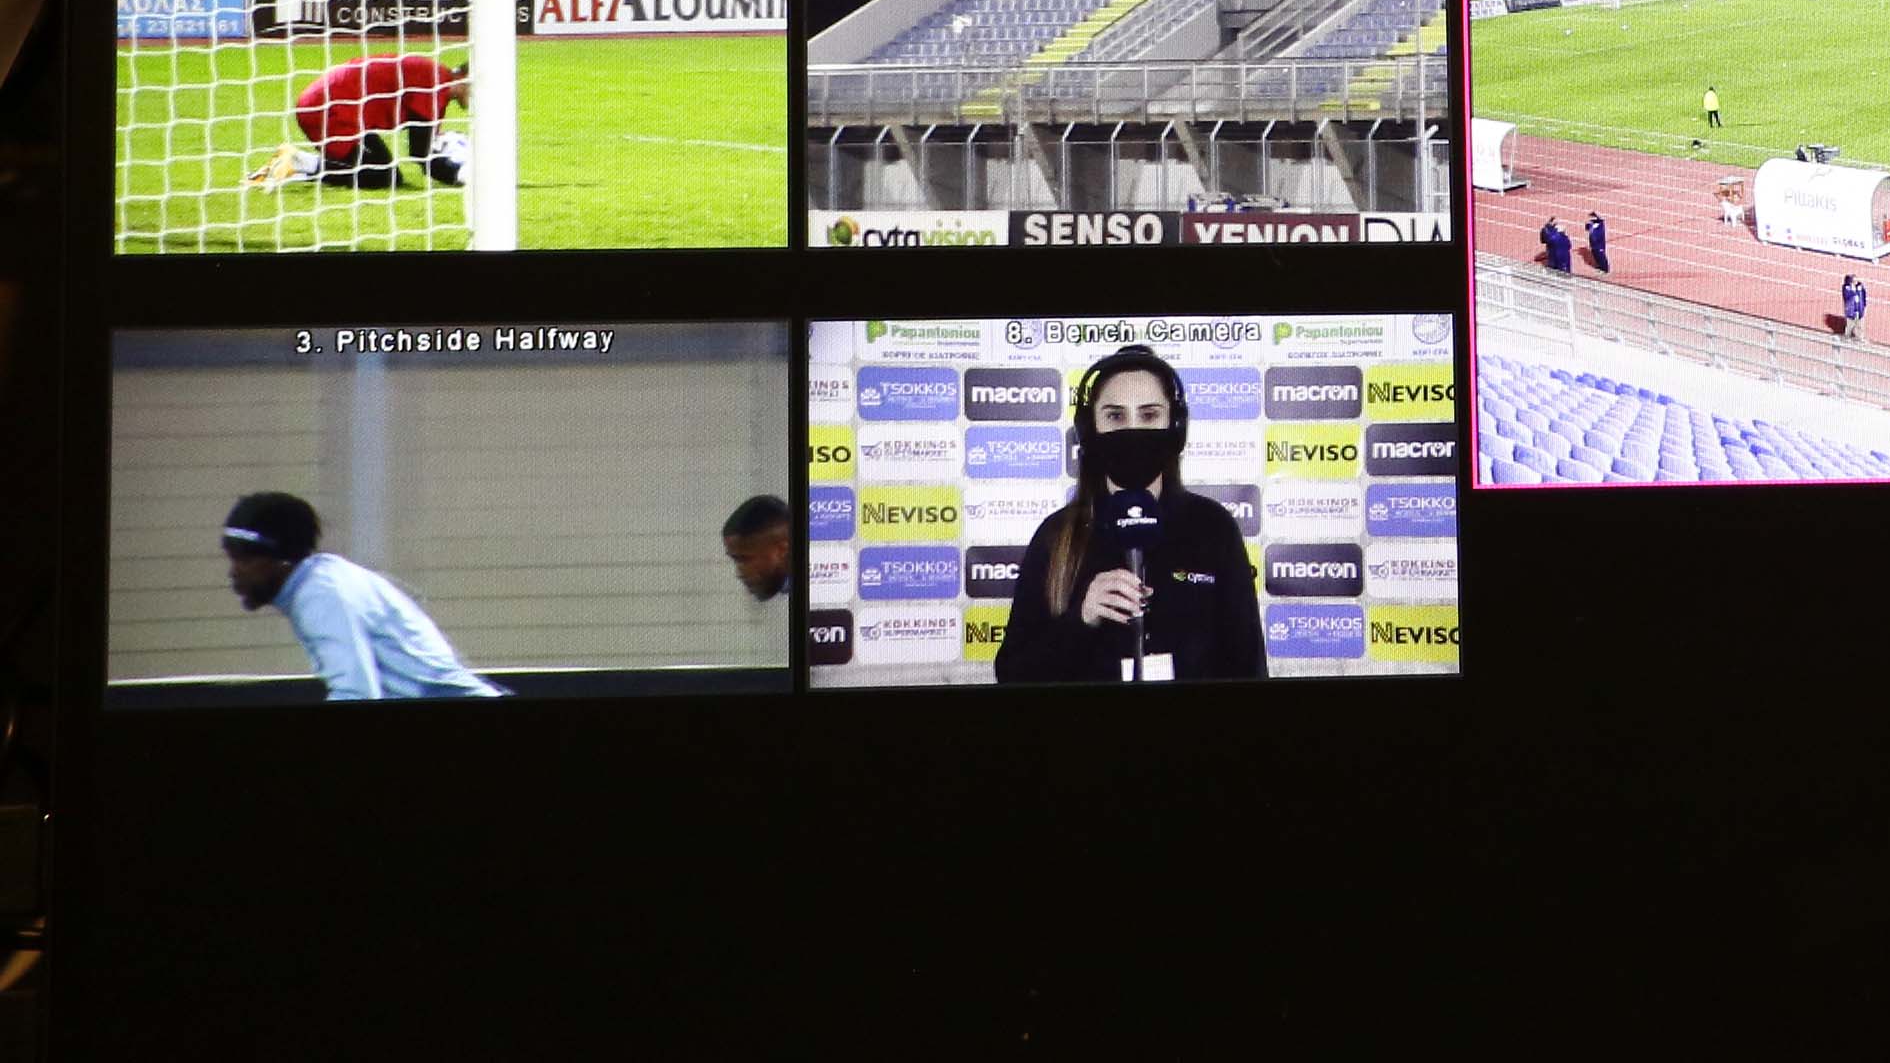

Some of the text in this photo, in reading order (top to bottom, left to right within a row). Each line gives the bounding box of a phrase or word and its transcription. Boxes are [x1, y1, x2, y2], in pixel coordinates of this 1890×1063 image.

[1023, 212, 1164, 246] SENSO
[296, 328, 615, 354] 3. Pitchside Halfway
[1006, 319, 1261, 345] 8. Bench Camera
[880, 381, 957, 397] TSOKKOS
[970, 385, 1057, 405] macron
[1273, 383, 1358, 403] macron
[987, 440, 1061, 455] TSOKKOS
[1266, 440, 1358, 463] NEVISO
[862, 502, 958, 525] NEVISO
[1271, 560, 1358, 580] macron
[1286, 616, 1363, 631] TSOKKOS
